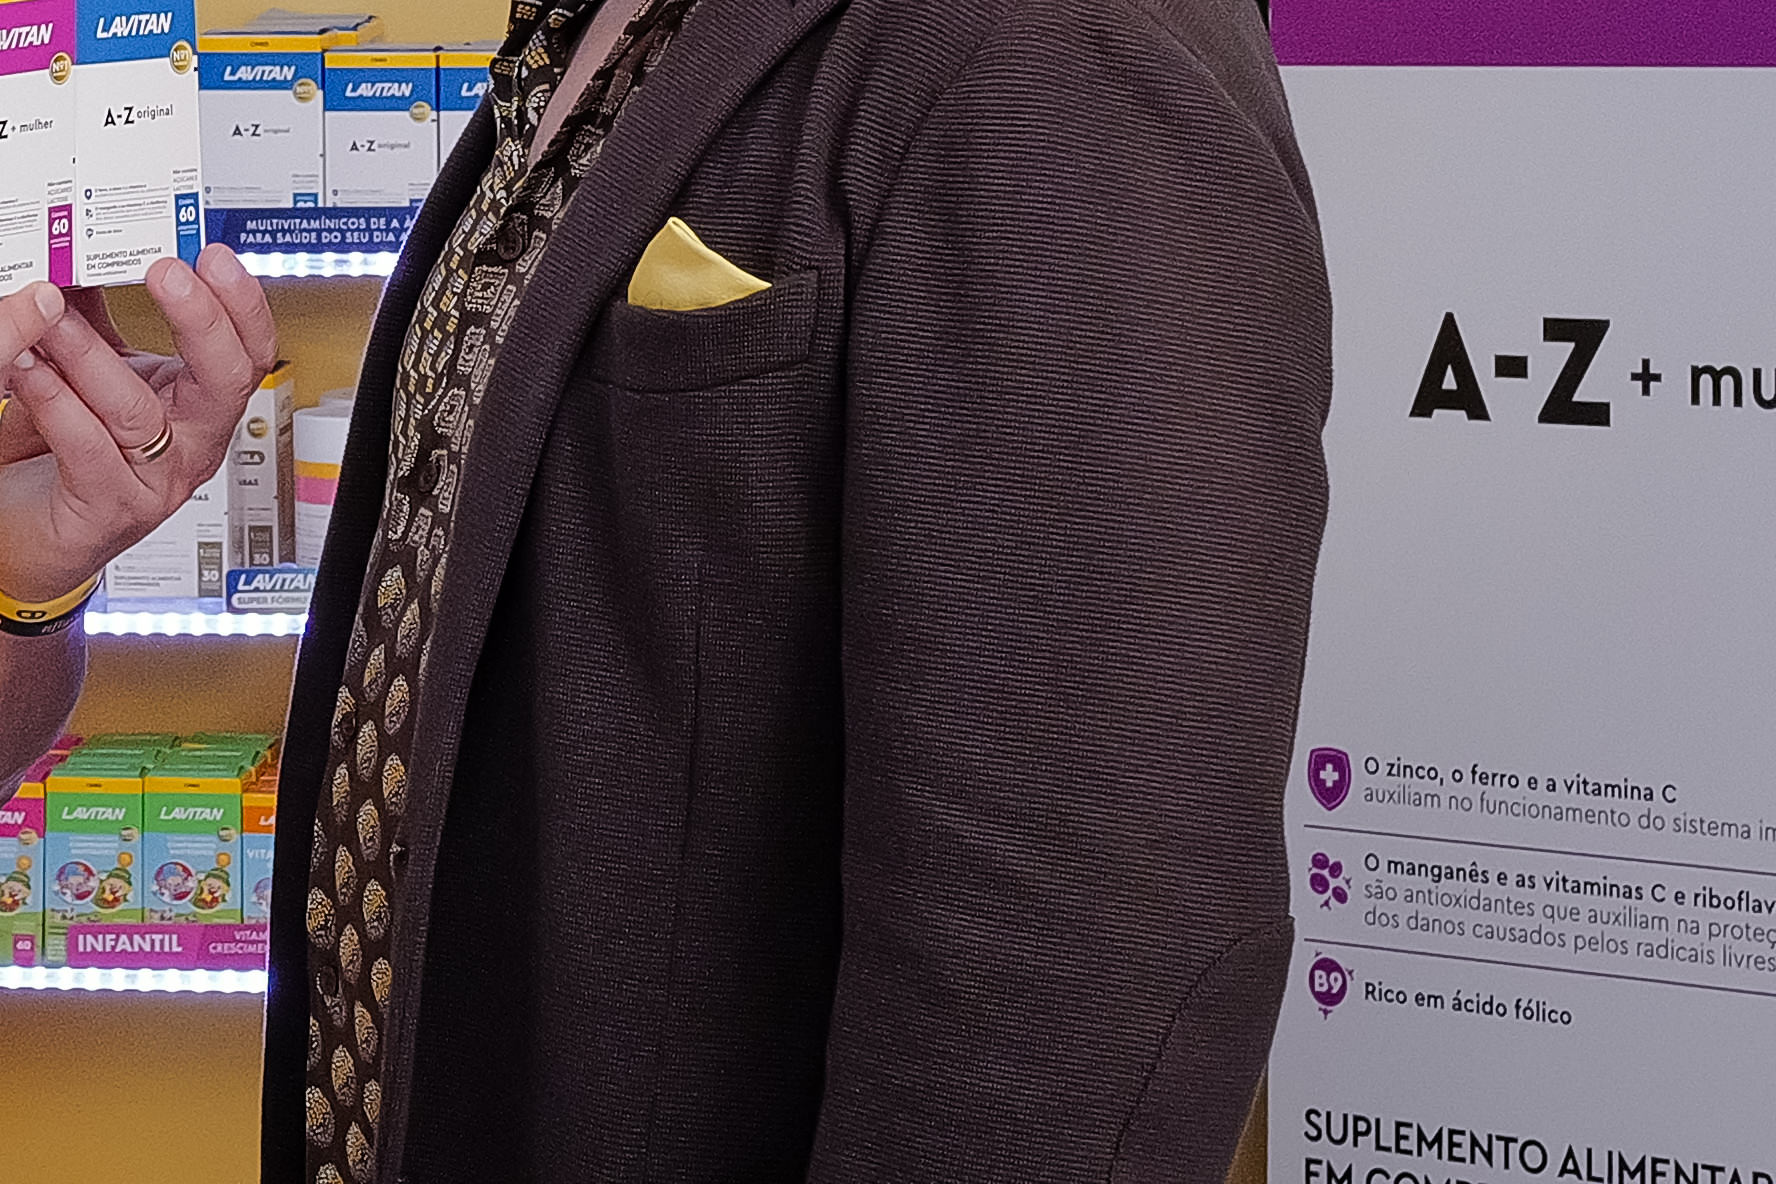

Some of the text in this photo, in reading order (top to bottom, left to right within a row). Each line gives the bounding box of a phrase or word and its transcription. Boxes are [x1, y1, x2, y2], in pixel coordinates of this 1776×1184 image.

[96, 12, 172, 39] LAVITAN
[224, 65, 295, 81] LAVITAN
[19, 119, 53, 133] mulher
[104, 104, 173, 127] A-Z original
[232, 124, 261, 137] A-Z
[179, 206, 195, 222] 60
[246, 215, 400, 230] MULTIVITAMÍNICOS DE A
[52, 218, 69, 234] 60
[240, 230, 395, 244] PARA SAÚDE DO SEU DIA
[1408, 312, 1611, 427] A-Z
[1630, 357, 1662, 397] +
[1364, 756, 1678, 805] O zinco, o ferro e a vitamina C
[62, 807, 125, 820] LAVITAN
[160, 807, 224, 820] LAVITAN
[1364, 785, 1441, 809] auxiliam
[1449, 794, 1473, 812] no
[1480, 789, 1631, 828] funcionamento
[1638, 807, 1666, 832] do
[1673, 812, 1751, 840] sistema
[1364, 853, 1776, 914] O manganês e as vitaminas C e riboflav
[1364, 879, 1397, 901] são
[1404, 885, 1535, 917] antioxidantes
[1543, 902, 1581, 923] que
[1588, 906, 1669, 933] auxiliam
[1677, 917, 1700, 936] na
[78, 934, 183, 953] INFANTIL
[1364, 907, 1776, 972] dos danos causados pelos radicais livres
[1314, 969, 1343, 994] B9
[1364, 981, 1572, 1026] Rico em ácido fólico
[1304, 1108, 1548, 1175] SUPLEMENTO
